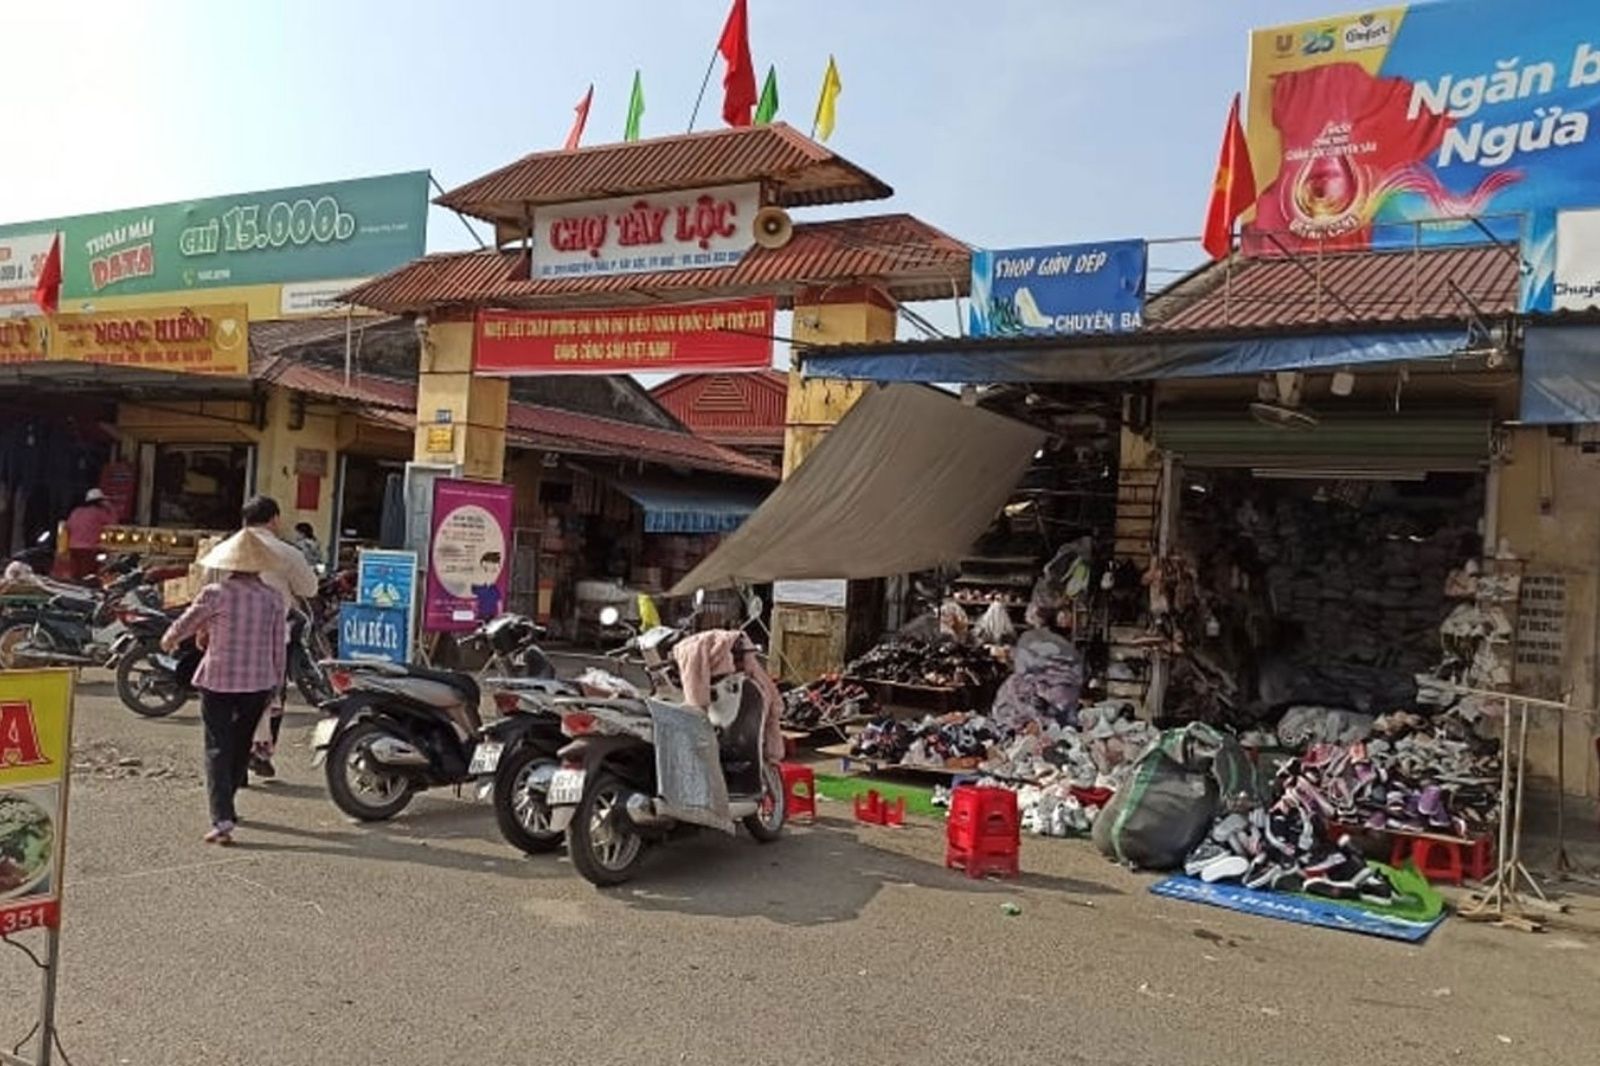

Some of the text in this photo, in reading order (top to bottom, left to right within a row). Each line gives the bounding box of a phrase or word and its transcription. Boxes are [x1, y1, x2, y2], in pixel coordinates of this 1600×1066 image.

[1407, 56, 1555, 121] Ngăn
[1437, 105, 1590, 169] Ngừa
[550, 194, 736, 258] CHỢ TÂY LỘC
[90, 242, 154, 290] DATA
[995, 255, 1034, 279] SHOP
[94, 319, 149, 351] NGỌC
[153, 306, 214, 343] HIỀN
[1055, 308, 1114, 332] CHUYÊN
[3, 908, 46, 932] 351
